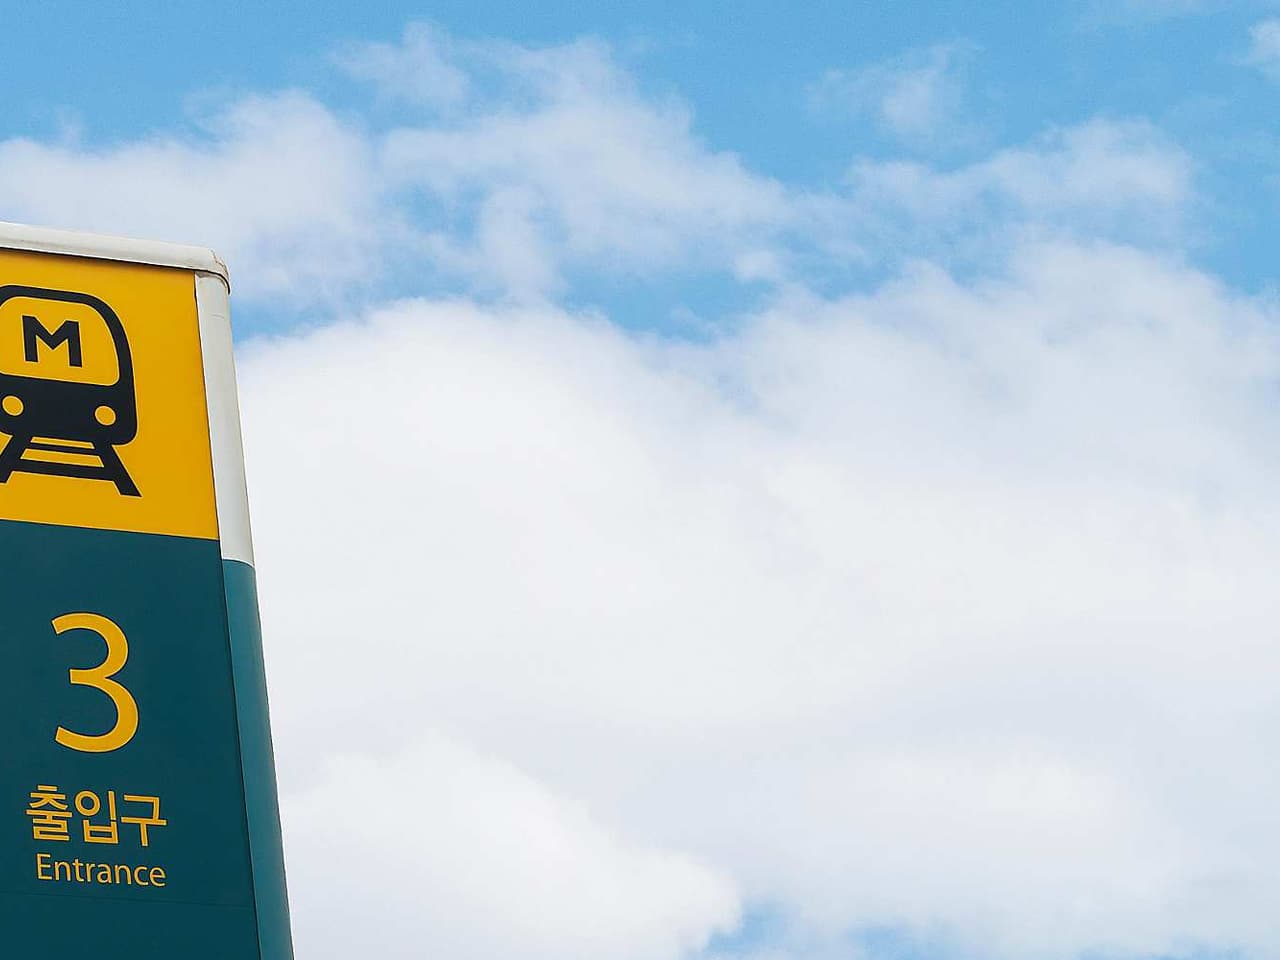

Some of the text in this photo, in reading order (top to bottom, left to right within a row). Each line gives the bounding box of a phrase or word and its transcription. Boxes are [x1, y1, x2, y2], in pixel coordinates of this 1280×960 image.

[22, 314, 84, 368] M
[51, 612, 139, 753] 3
[25, 784, 168, 847] 출입구
[36, 852, 168, 888] Entrance
